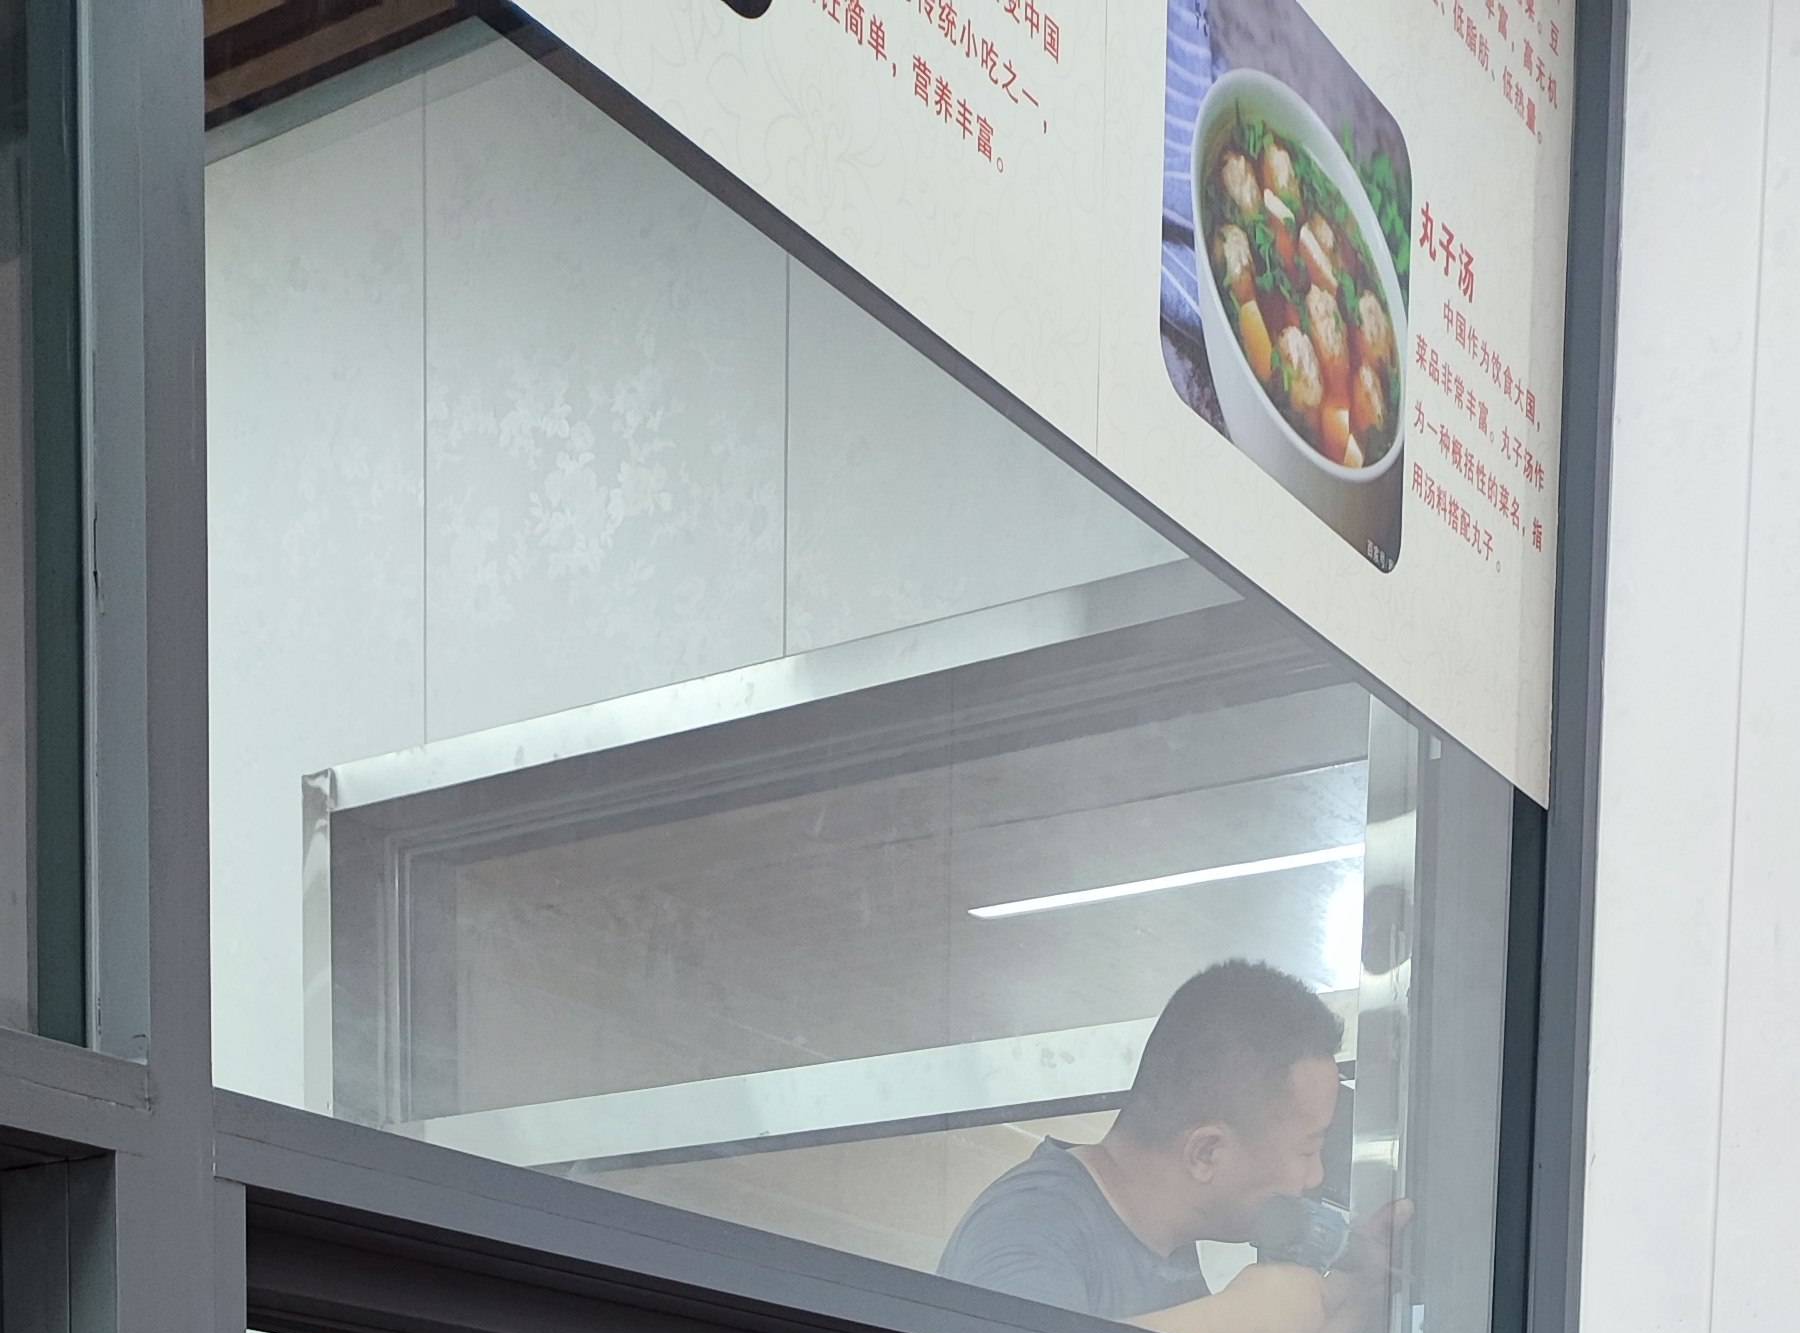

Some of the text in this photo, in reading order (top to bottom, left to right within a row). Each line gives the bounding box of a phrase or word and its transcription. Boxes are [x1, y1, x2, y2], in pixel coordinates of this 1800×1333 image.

[1418, 201, 1475, 303] 丸子汤
[1415, 333, 1545, 493] 菜品非常丰富。丸子汤作
[1443, 299, 1541, 432] 中国作为饮食大国，
[1411, 461, 1501, 573] 用汤料搭配丸子。
[1413, 400, 1543, 552] 为一种概括性的菜名，指
